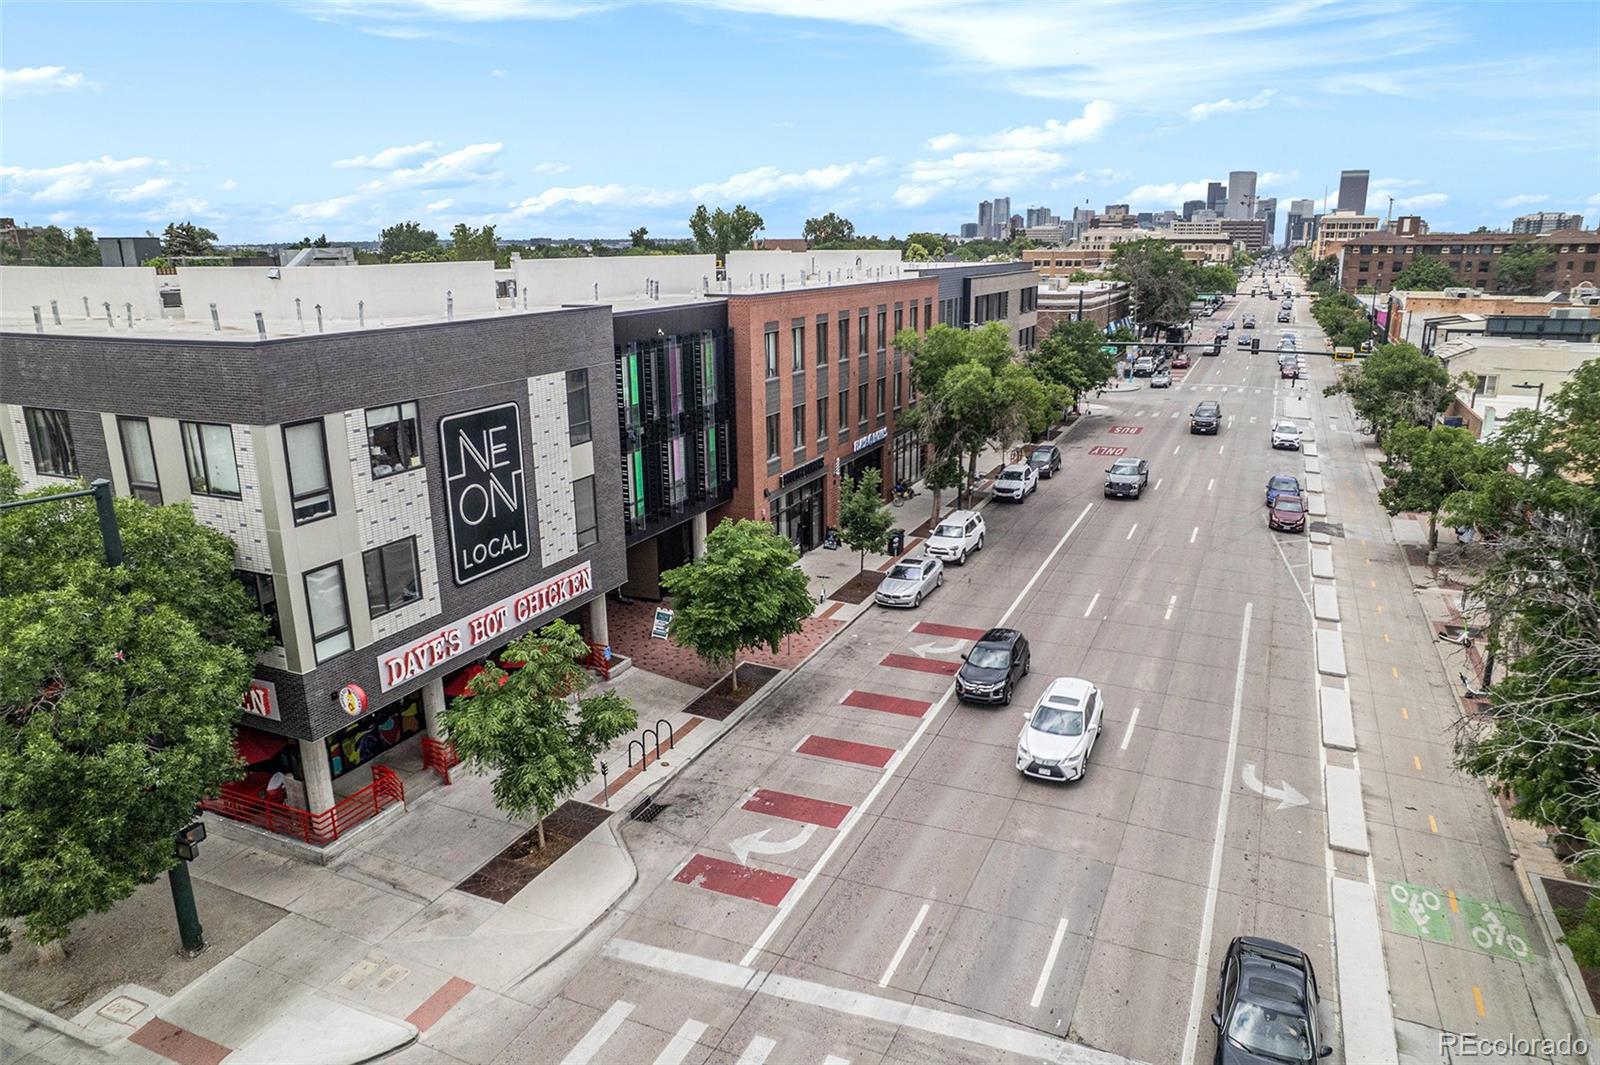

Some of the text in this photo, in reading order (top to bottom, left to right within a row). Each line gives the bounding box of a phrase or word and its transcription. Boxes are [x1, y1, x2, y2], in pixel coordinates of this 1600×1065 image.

[1113, 426, 1138, 434] BUS
[1090, 447, 1124, 455] ONLY
[463, 530, 522, 570] LOCAL
[386, 568, 592, 687] DAVE'S HOT CHICKEN
